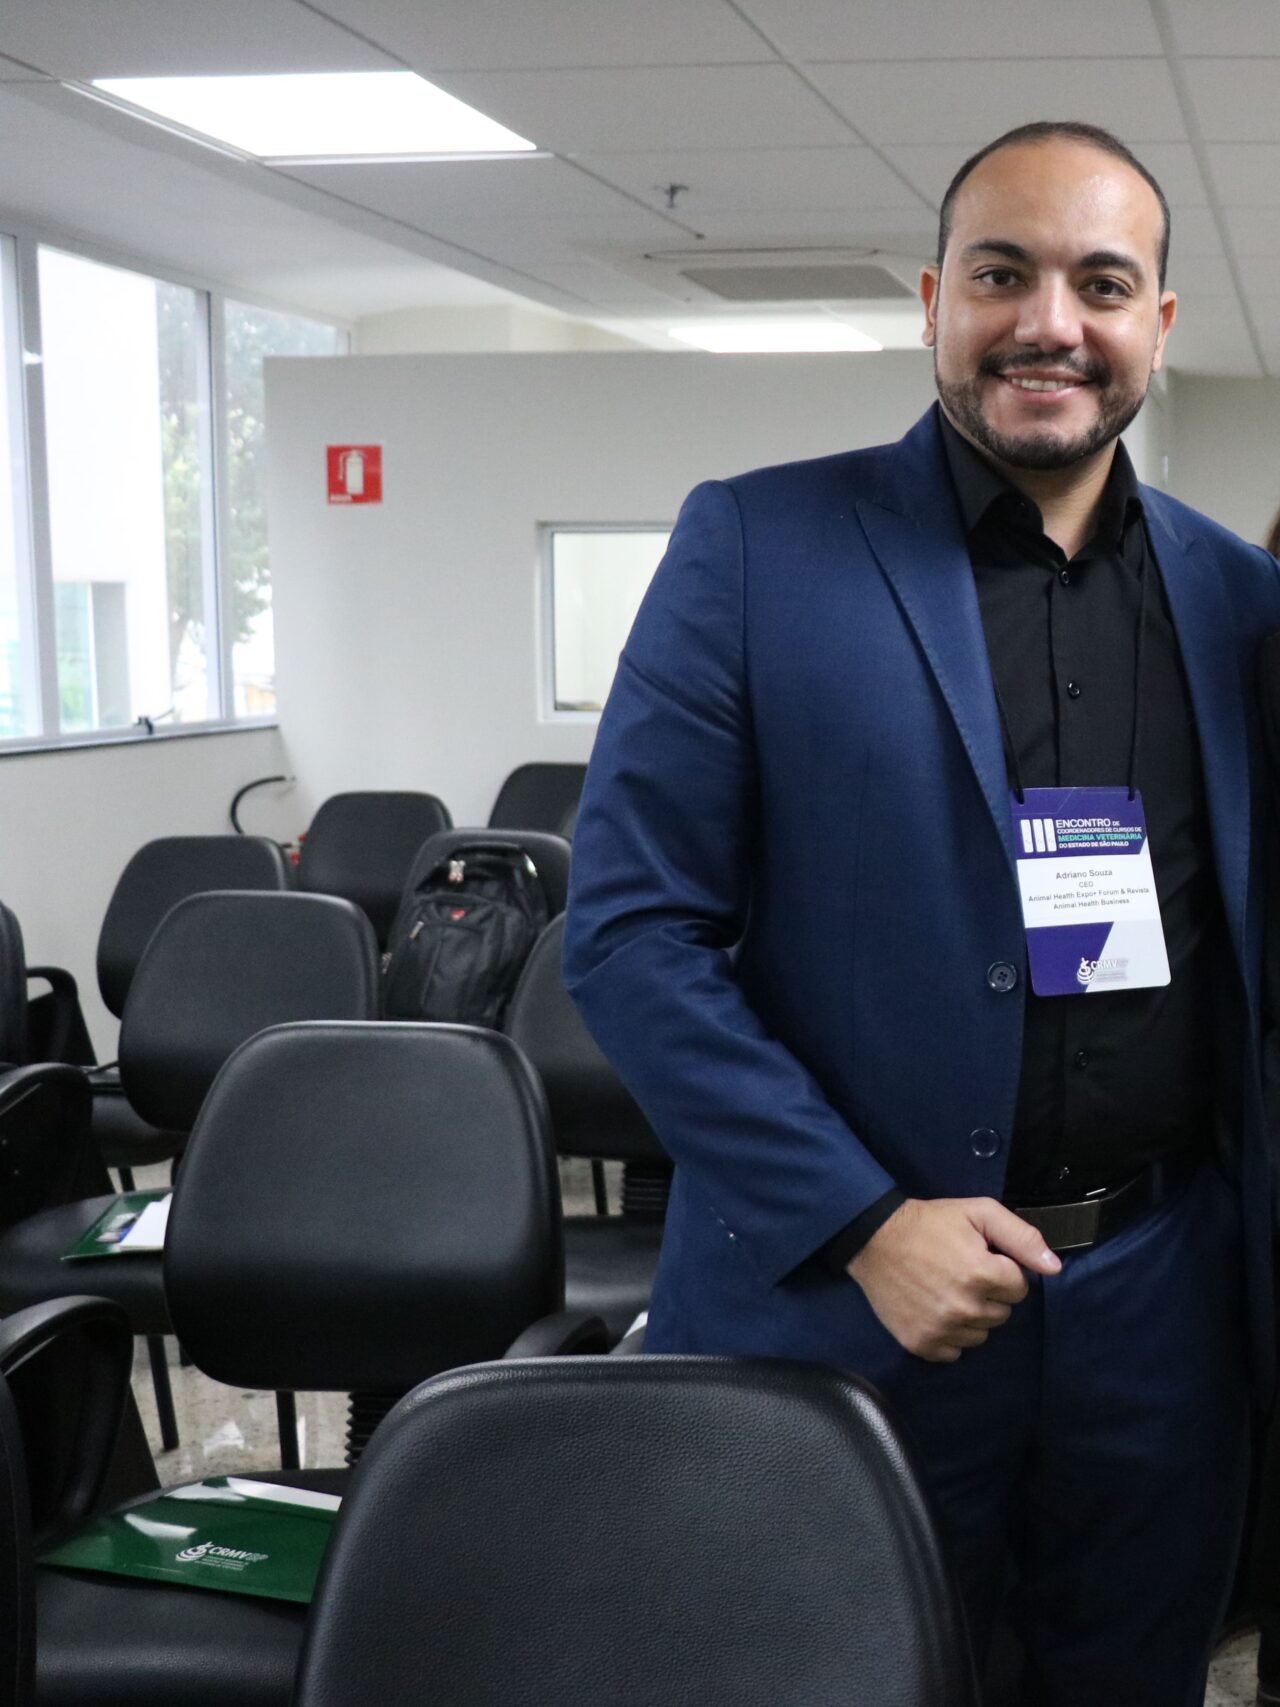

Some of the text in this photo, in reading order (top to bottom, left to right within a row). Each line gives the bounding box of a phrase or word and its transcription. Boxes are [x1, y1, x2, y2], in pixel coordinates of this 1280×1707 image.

[1056, 818, 1111, 828] ENCONTRO
[1058, 832, 1142, 842] MEDICINA VETERINÁRIA
[1055, 869, 1113, 880] Adriano Souza
[1028, 894, 1052, 902] Animal
[1053, 892, 1075, 900] Health
[1098, 889, 1120, 897] Forum
[1053, 898, 1130, 910] Animal Health Business
